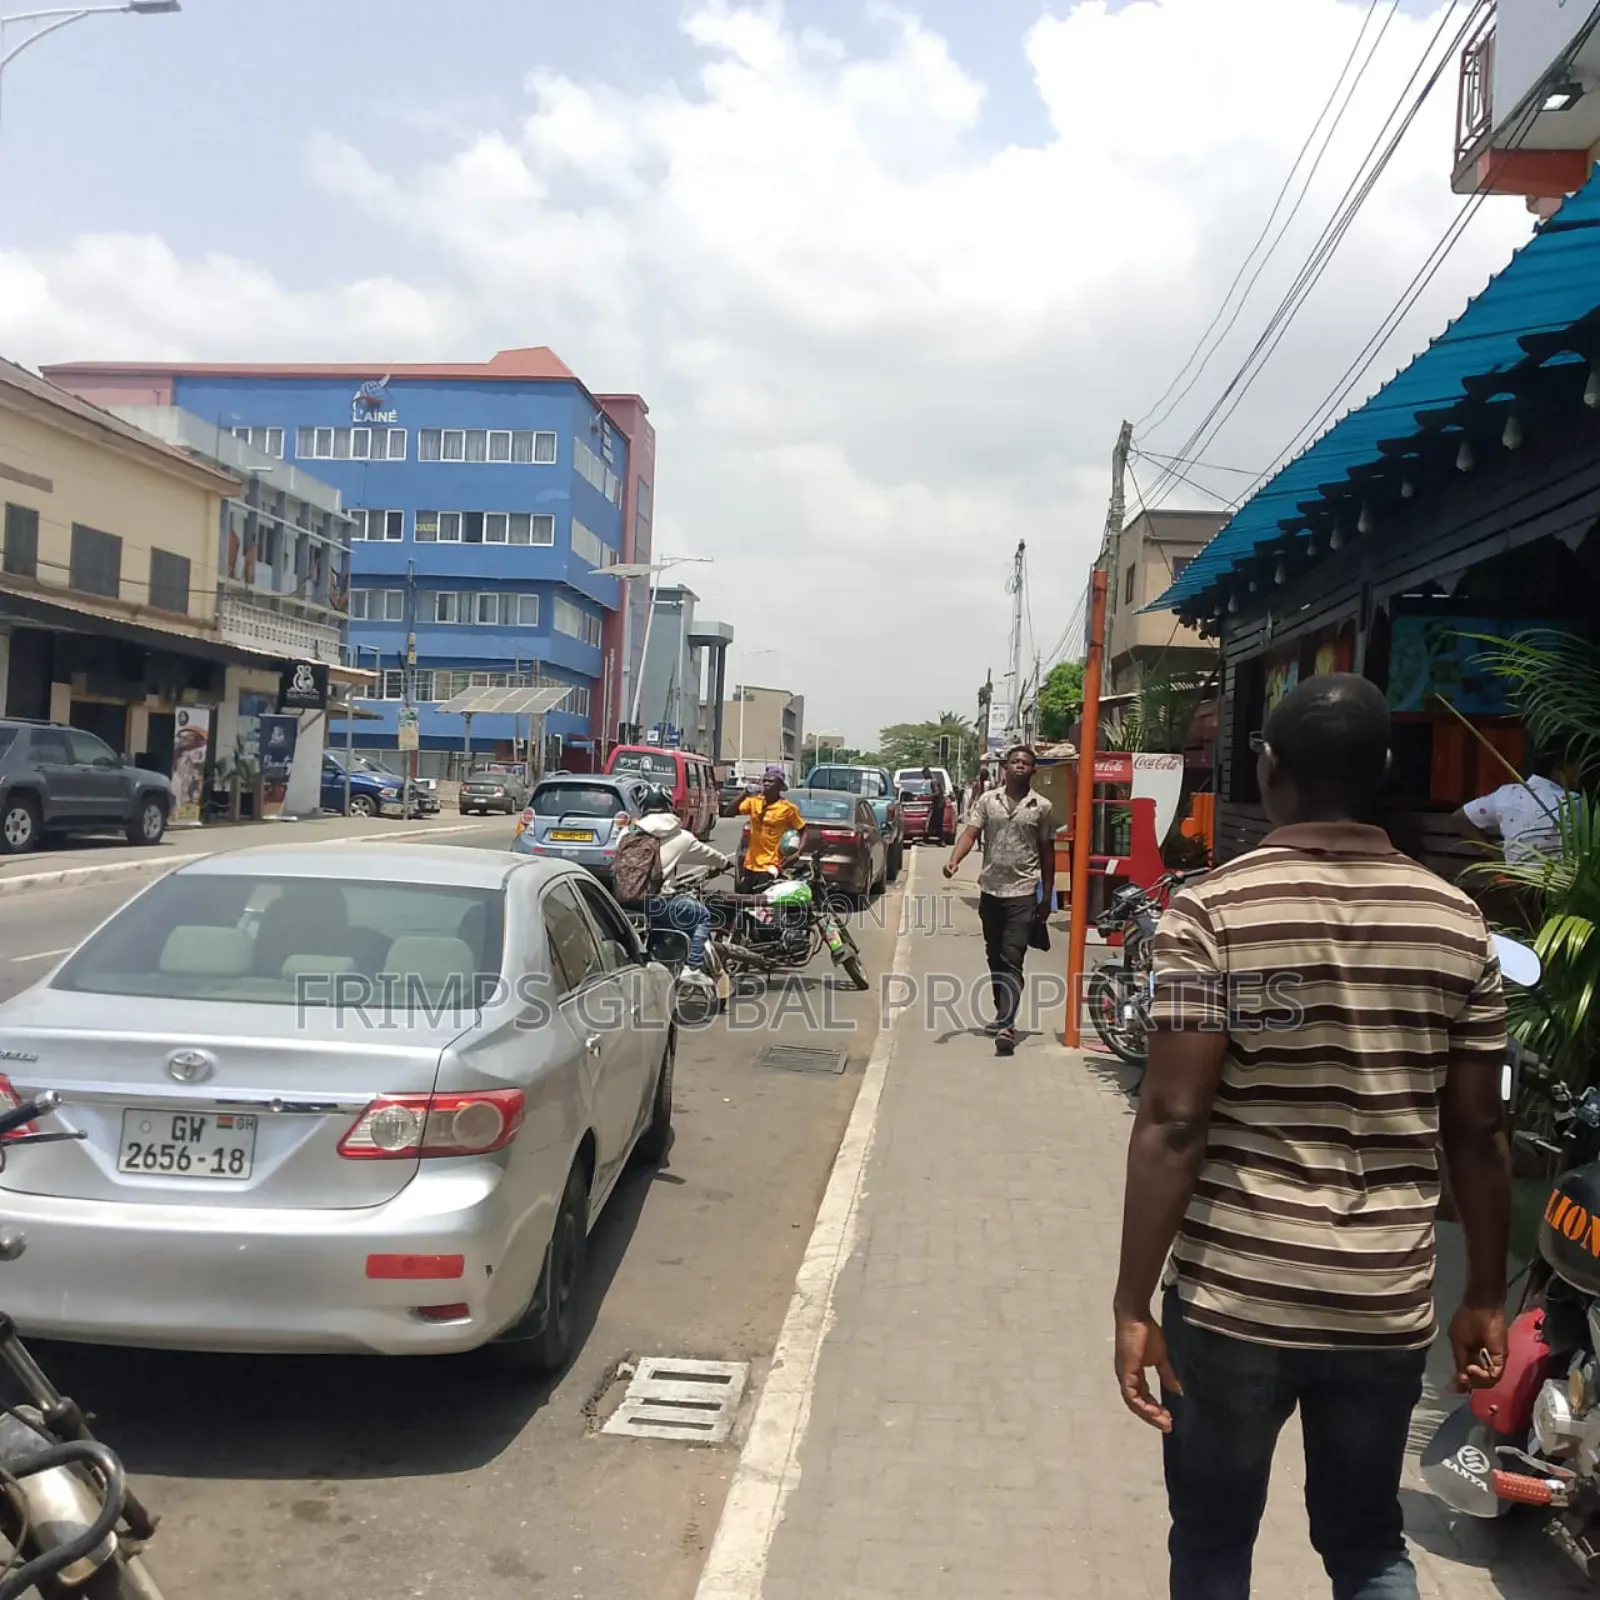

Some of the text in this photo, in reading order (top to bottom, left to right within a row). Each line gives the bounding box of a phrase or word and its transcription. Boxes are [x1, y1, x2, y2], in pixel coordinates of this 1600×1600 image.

[171, 1115, 207, 1143] GW
[125, 1142, 245, 1175] 2656-18
[1441, 1458, 1490, 1493] SANYA
